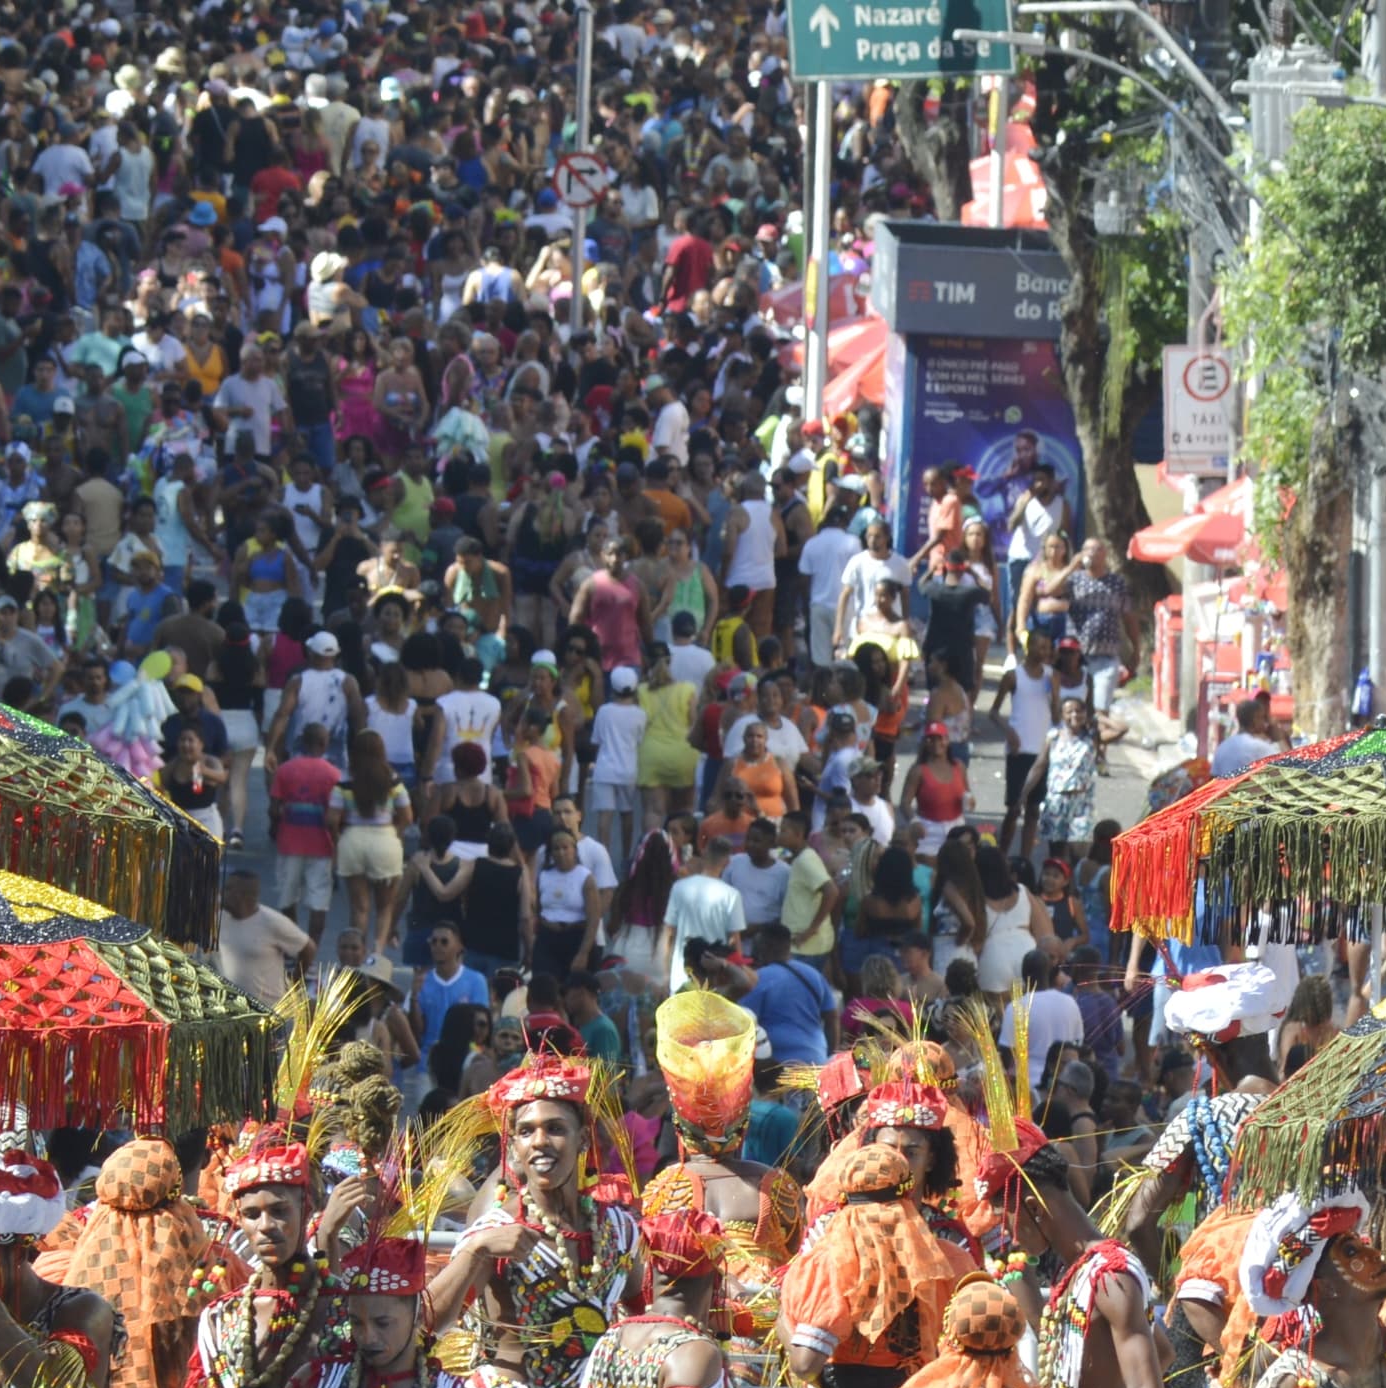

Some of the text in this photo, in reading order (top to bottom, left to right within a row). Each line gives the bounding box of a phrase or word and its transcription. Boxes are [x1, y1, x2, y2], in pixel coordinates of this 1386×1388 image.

[854, 0, 941, 26] Nazaré
[856, 38, 921, 65] Praça
[933, 281, 977, 304] TIM
[1015, 272, 1071, 296] Banc
[1014, 300, 1042, 320] do
